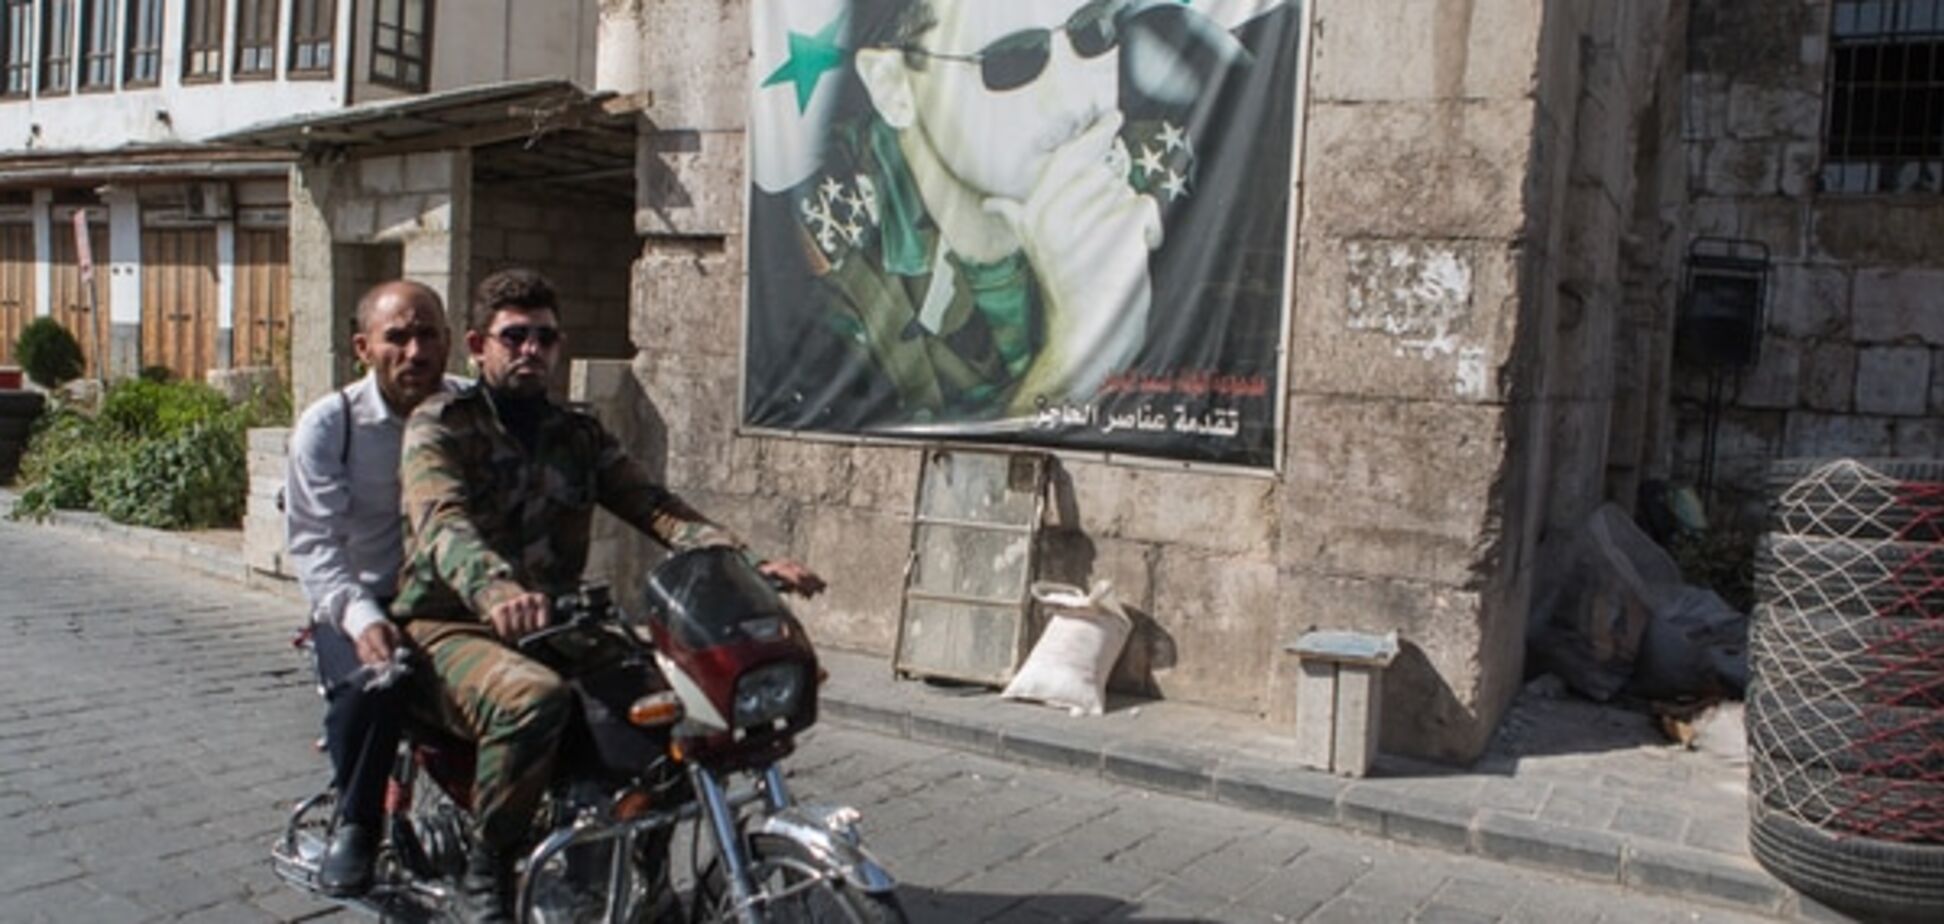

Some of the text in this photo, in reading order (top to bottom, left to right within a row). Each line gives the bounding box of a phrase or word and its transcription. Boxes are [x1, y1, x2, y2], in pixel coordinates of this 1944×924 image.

[1032, 397, 1239, 437] تقدمة عناصر الحاجز
